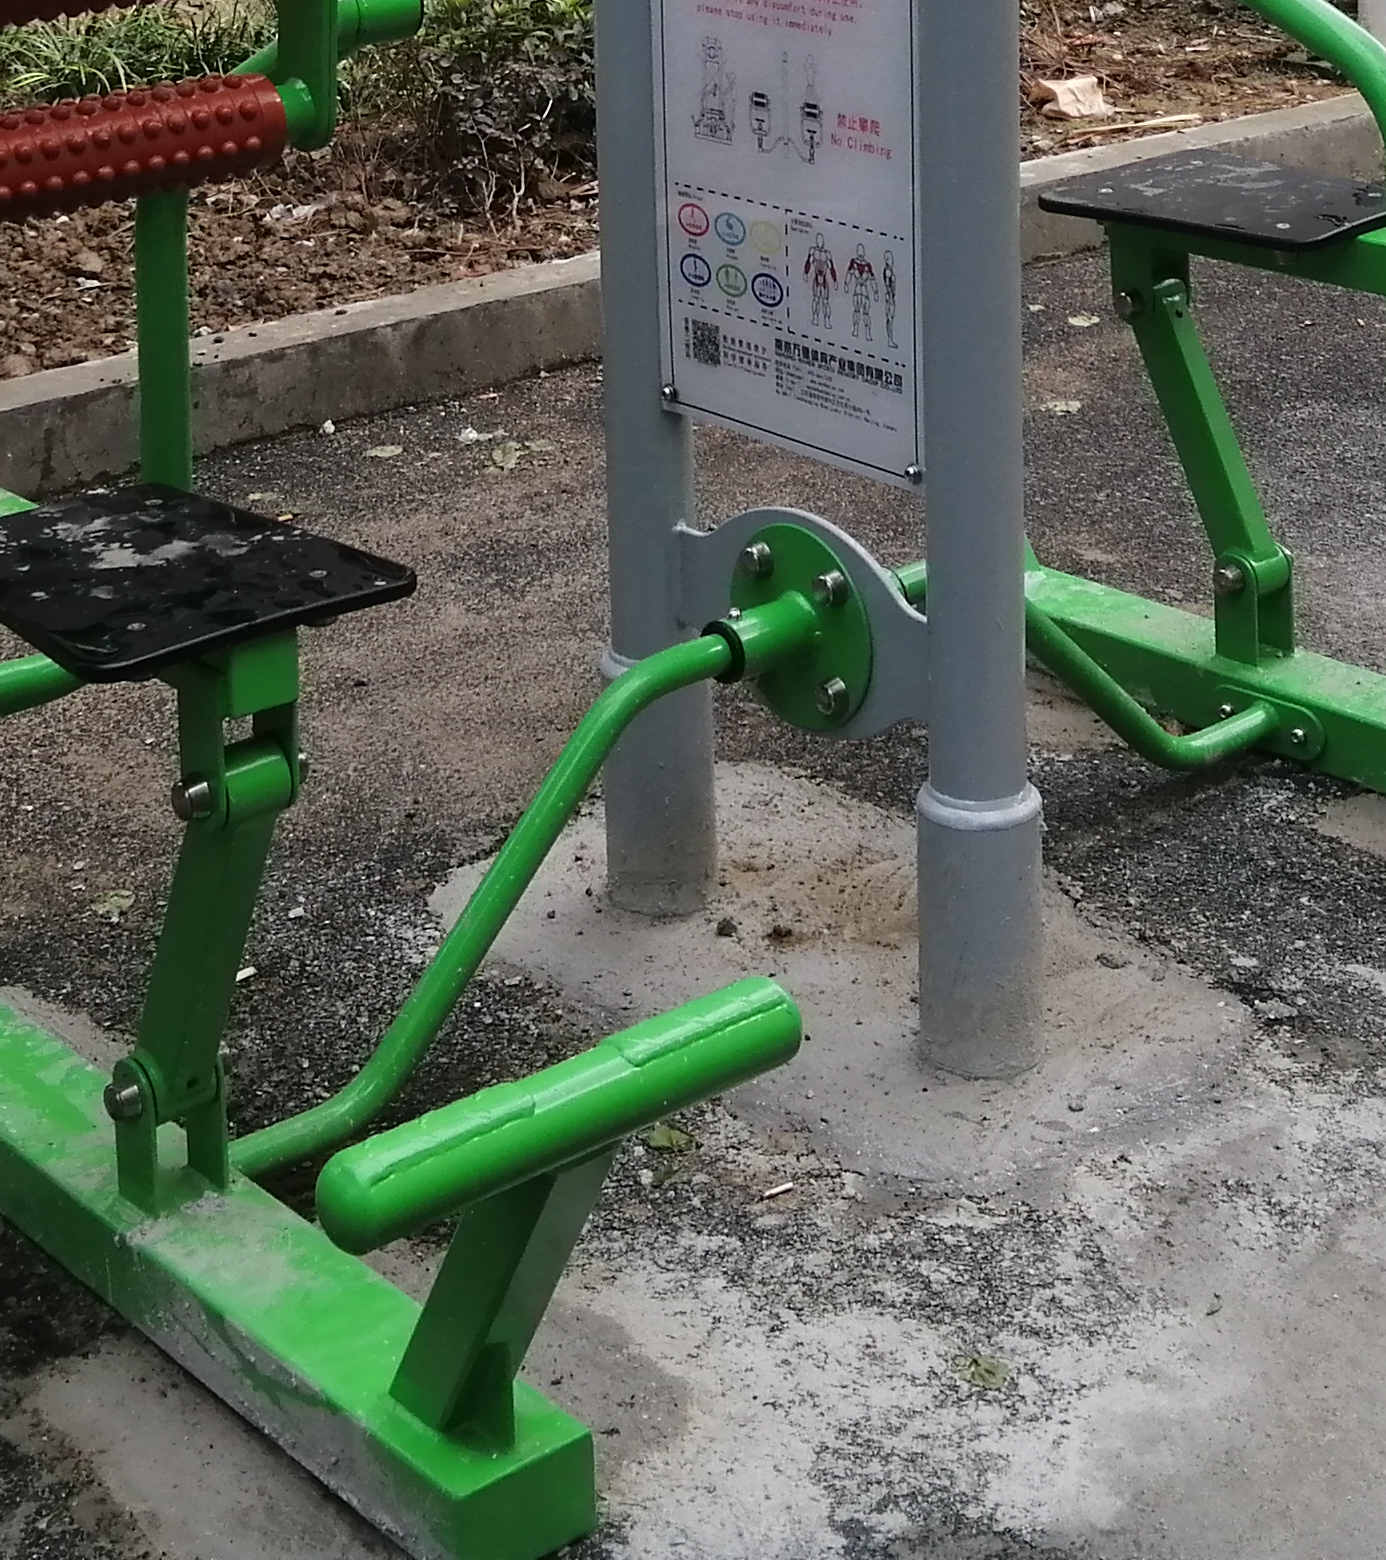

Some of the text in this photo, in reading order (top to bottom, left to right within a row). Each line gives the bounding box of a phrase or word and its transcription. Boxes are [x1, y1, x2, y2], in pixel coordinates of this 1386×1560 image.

[837, 113, 881, 137] 禁止攀爬
[830, 132, 893, 161] No Climbing
